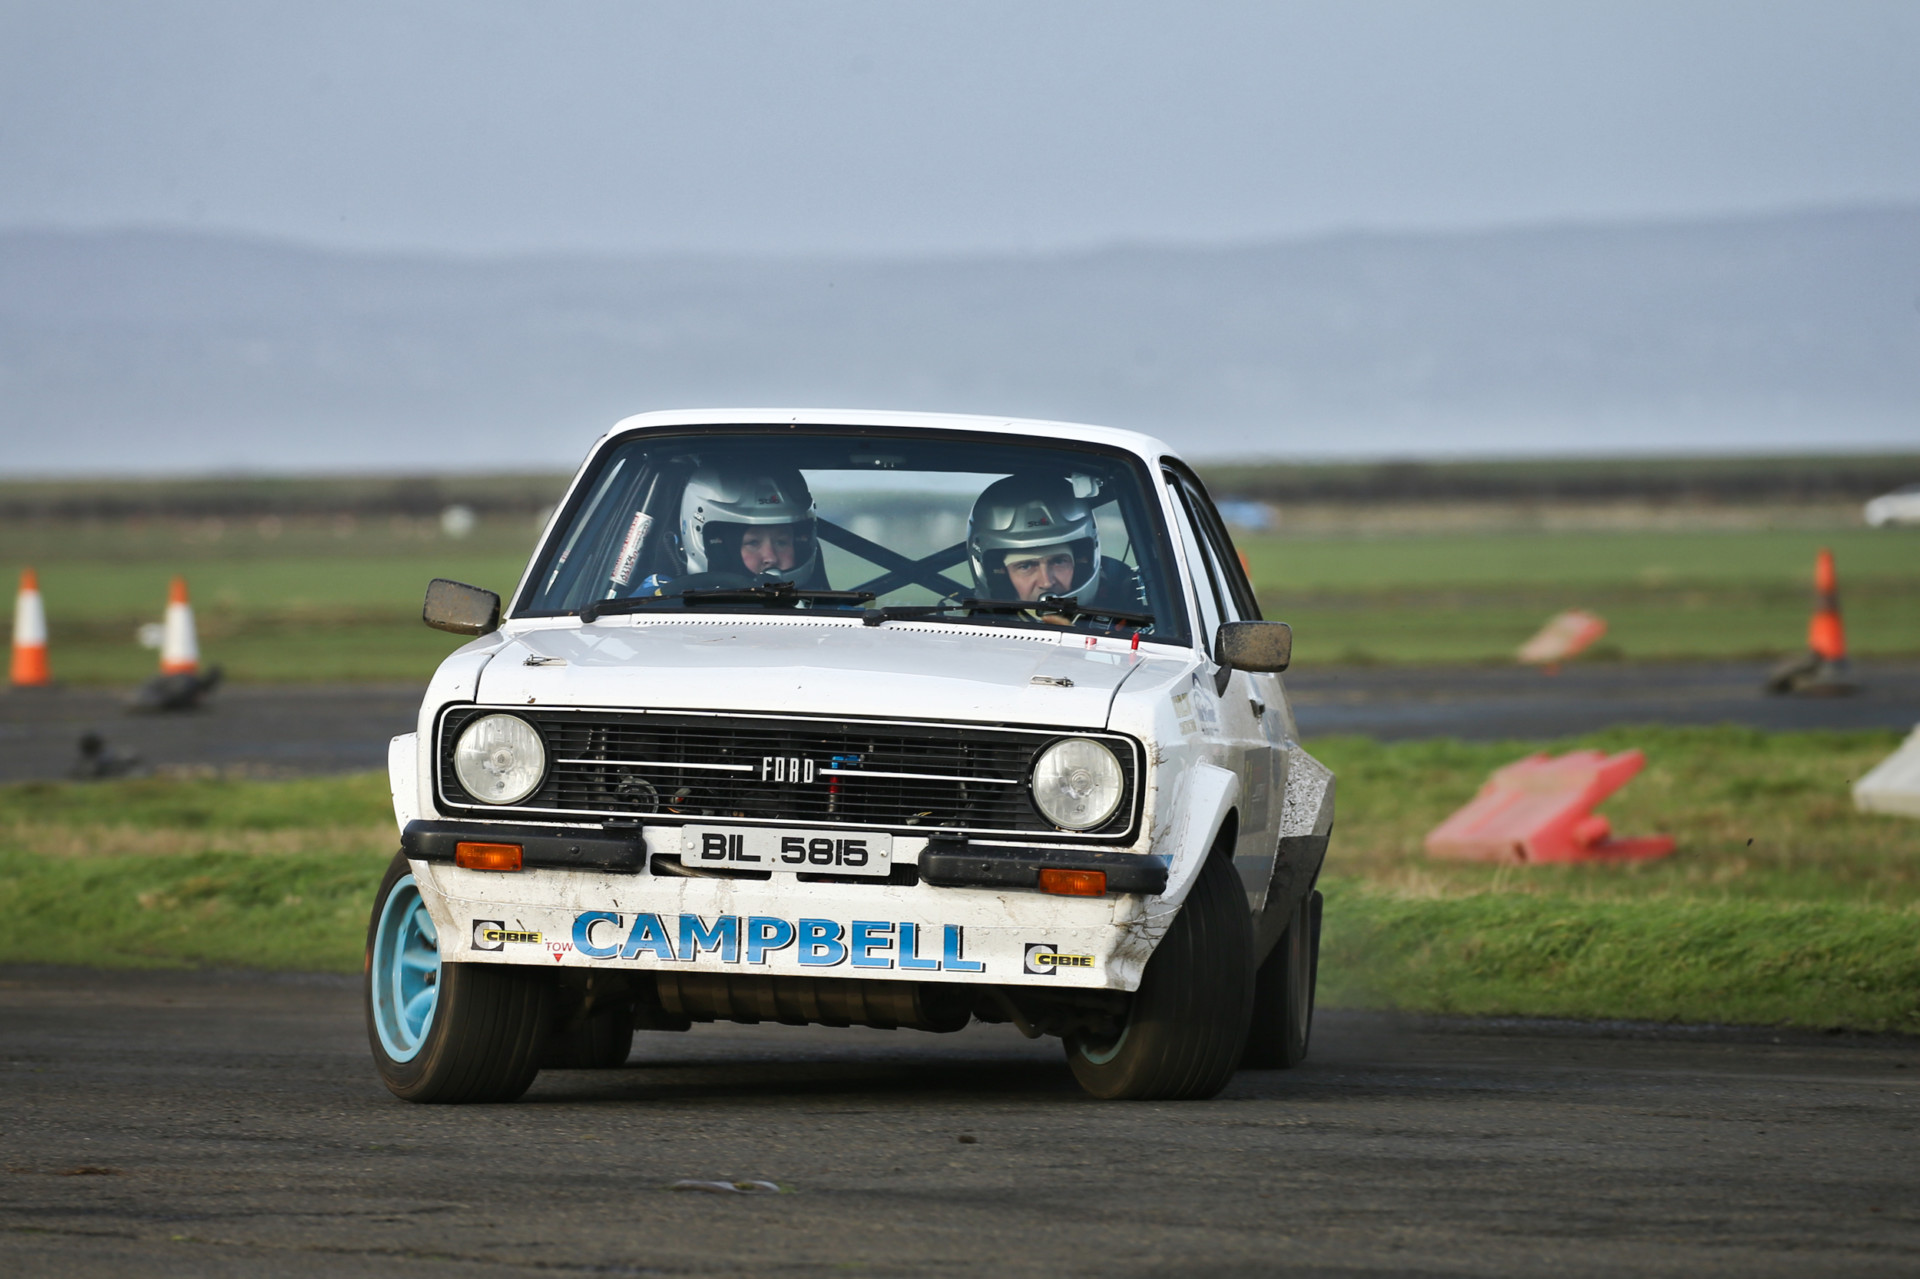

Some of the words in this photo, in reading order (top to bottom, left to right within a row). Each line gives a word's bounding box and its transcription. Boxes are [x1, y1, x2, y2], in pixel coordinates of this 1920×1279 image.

[762, 756, 814, 783] FORD
[701, 833, 761, 862] BIL
[781, 836, 869, 866] 5815
[486, 931, 539, 943] CIBIE
[545, 942, 574, 951] TOW
[571, 910, 986, 973] CAMPBELL
[1038, 954, 1092, 967] CIBIE
